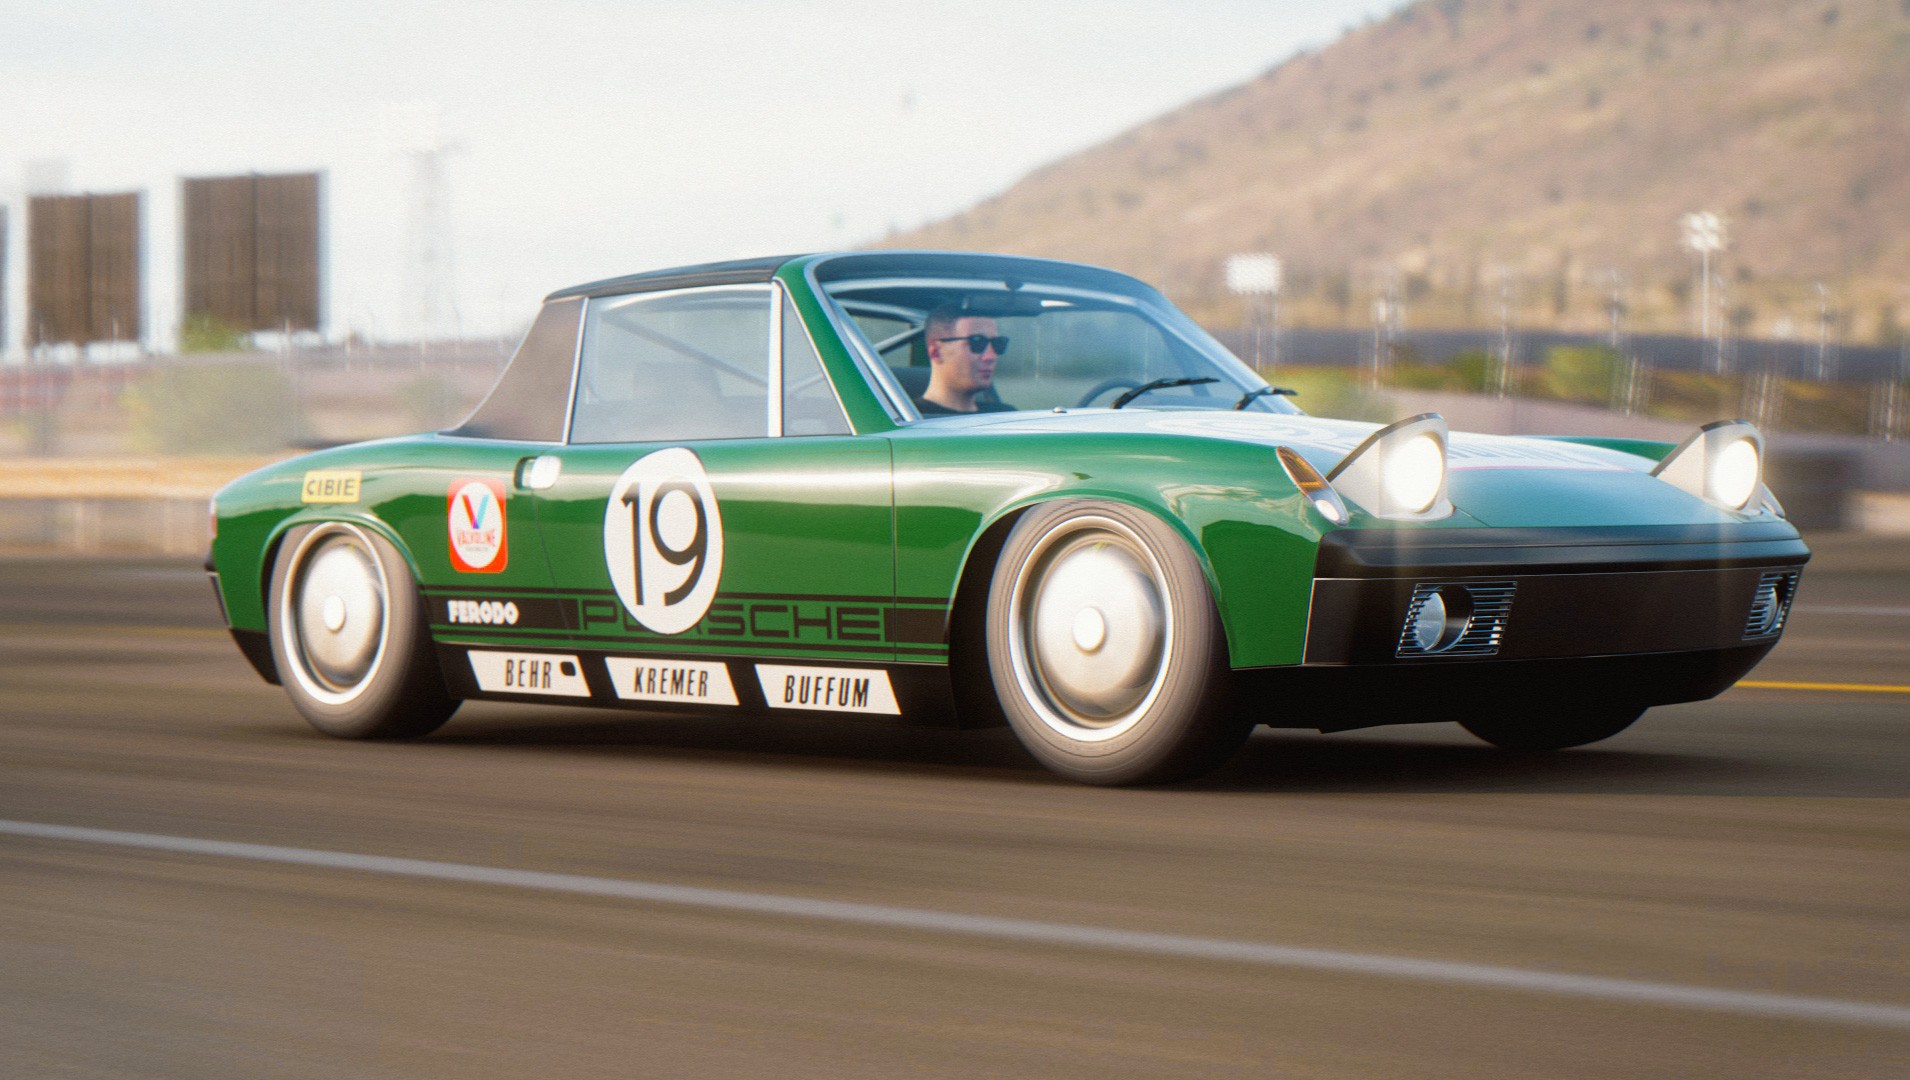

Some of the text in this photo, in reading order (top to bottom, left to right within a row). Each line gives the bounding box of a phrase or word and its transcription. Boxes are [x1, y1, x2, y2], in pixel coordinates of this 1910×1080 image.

[306, 479, 354, 496] CIBIE
[621, 480, 707, 606] 19
[447, 600, 520, 625] FERODO
[583, 599, 881, 641] PSCHE
[505, 659, 551, 689] BEHR
[634, 667, 709, 698] KREMER
[784, 674, 870, 708] BUFFUM
